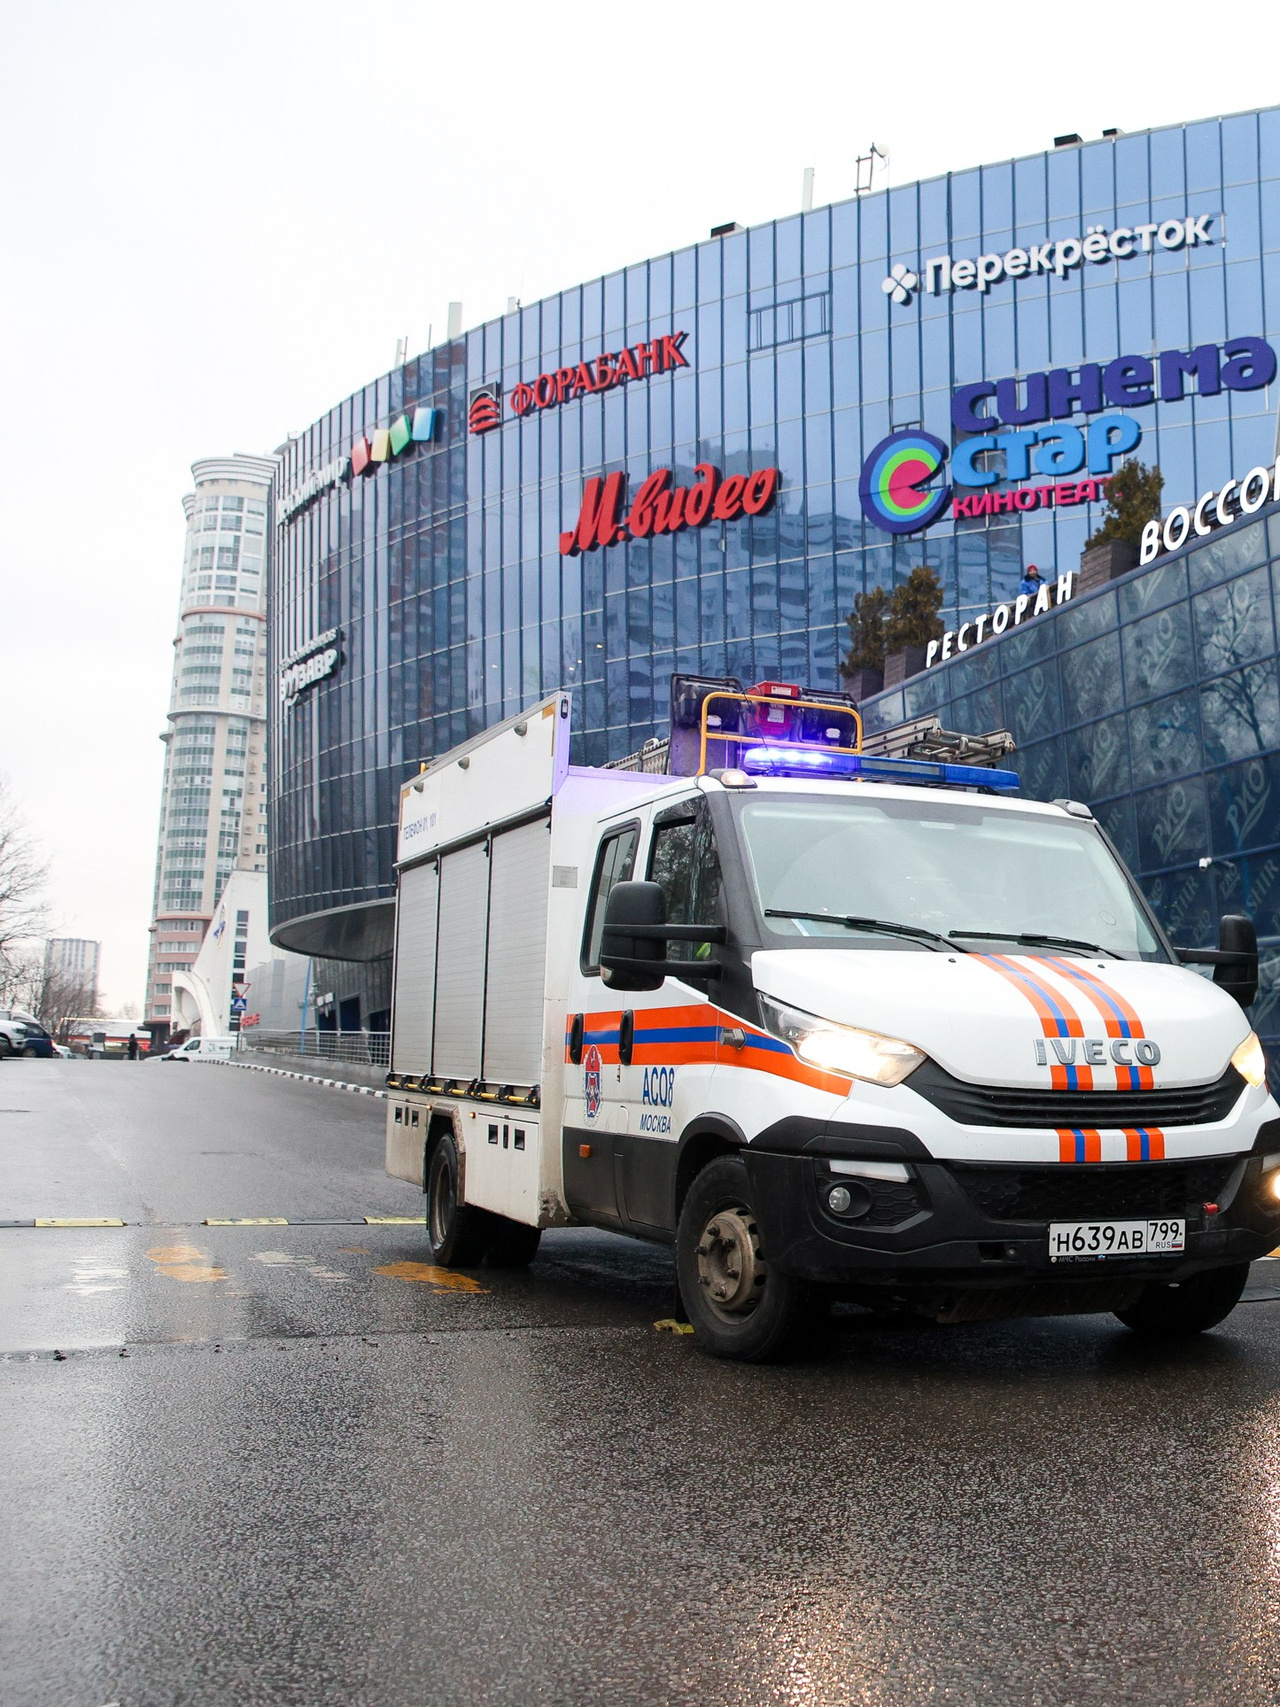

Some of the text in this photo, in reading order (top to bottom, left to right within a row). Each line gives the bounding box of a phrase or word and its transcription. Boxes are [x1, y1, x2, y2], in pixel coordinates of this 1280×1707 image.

[925, 213, 1213, 293] Перекрёсток
[510, 331, 689, 417] ФОРАБАНК
[925, 570, 1073, 668] РЕСТОРАН
[1152, 785, 1186, 855] РИО
[1226, 762, 1264, 838] РИО
[1033, 1038, 1161, 1066] IVECO
[640, 1113, 671, 1134] МОСКВА
[1149, 1222, 1179, 1241] 799
[1155, 1241, 1171, 1249] RUS
